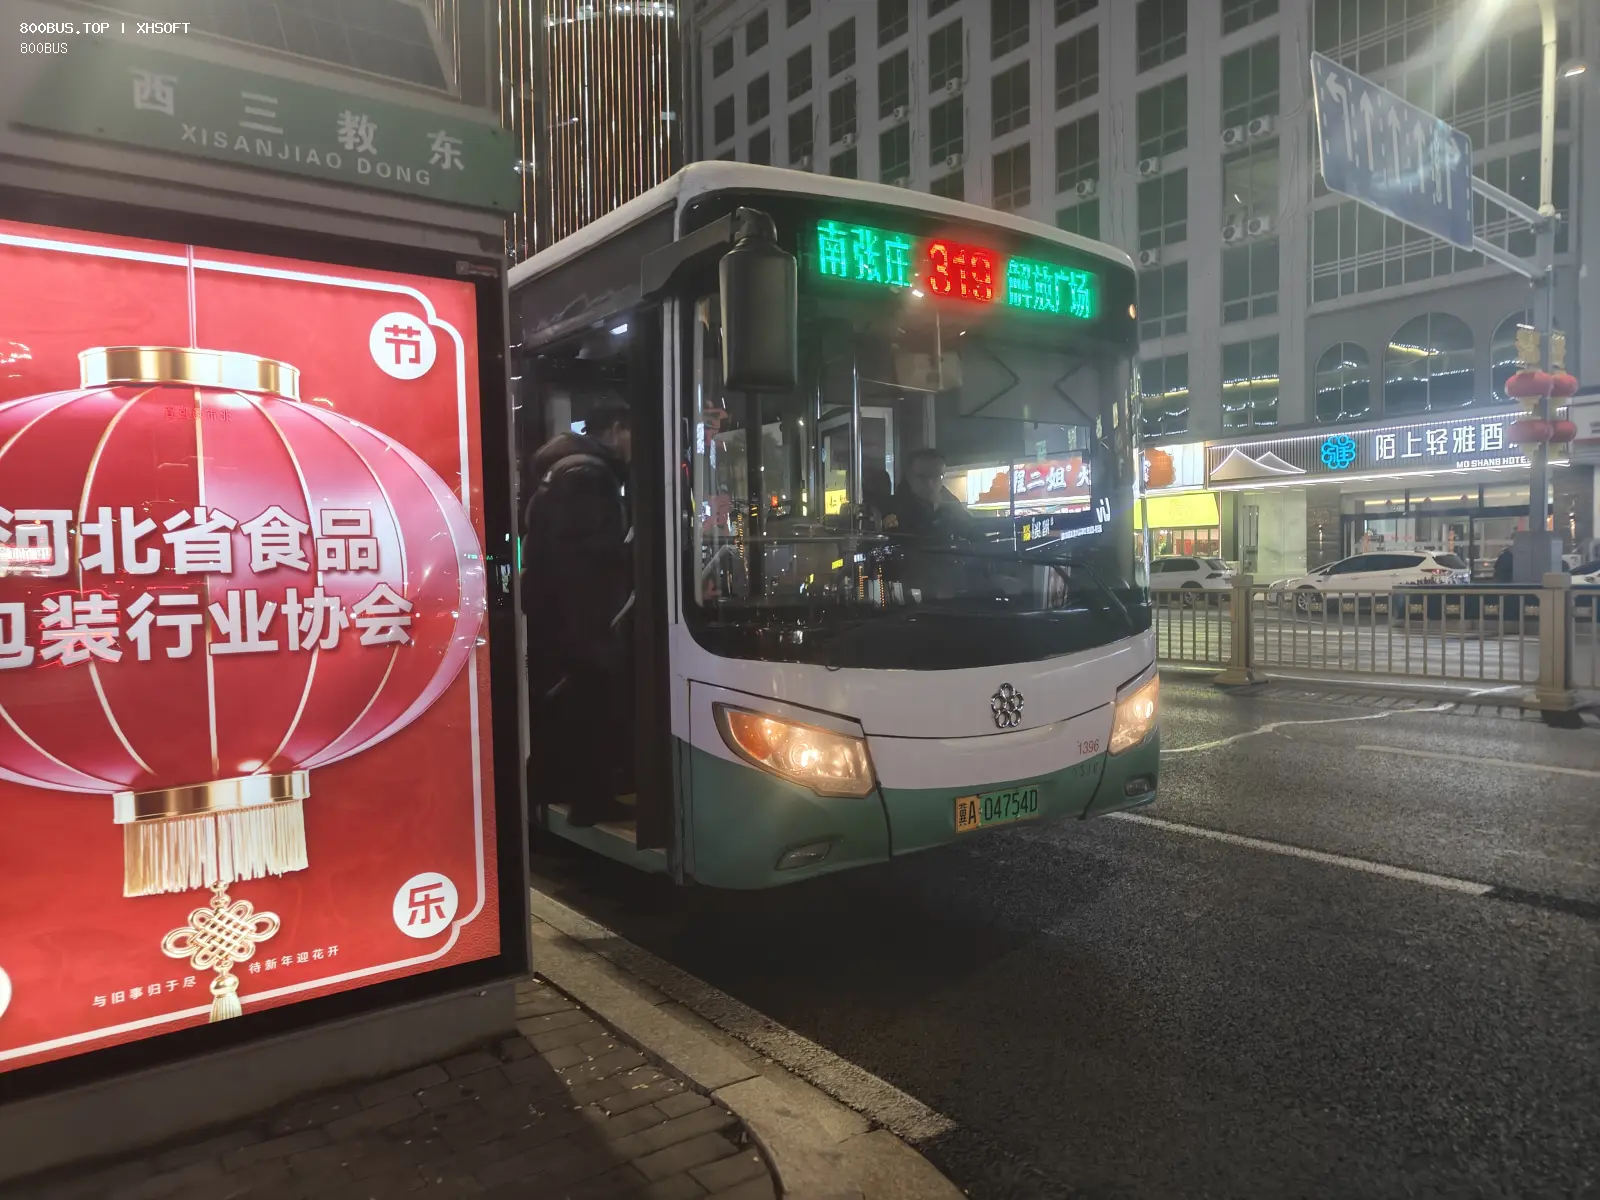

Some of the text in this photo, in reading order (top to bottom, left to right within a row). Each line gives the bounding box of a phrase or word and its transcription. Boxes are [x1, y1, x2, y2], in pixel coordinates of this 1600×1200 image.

[129, 68, 465, 171] 西三教东
[181, 123, 431, 186] XISANJIAO DONG
[817, 222, 913, 288] 南张庄
[929, 243, 993, 302] 319
[383, 323, 422, 365] 节
[1375, 420, 1519, 461] 陌上轻雅酒
[0, 504, 379, 578] 河北省食品
[1077, 738, 1100, 756] 1396
[407, 881, 447, 926] 乐
[248, 945, 340, 975] 待新年迎花开
[92, 975, 197, 1008] 与旧事归于尽
